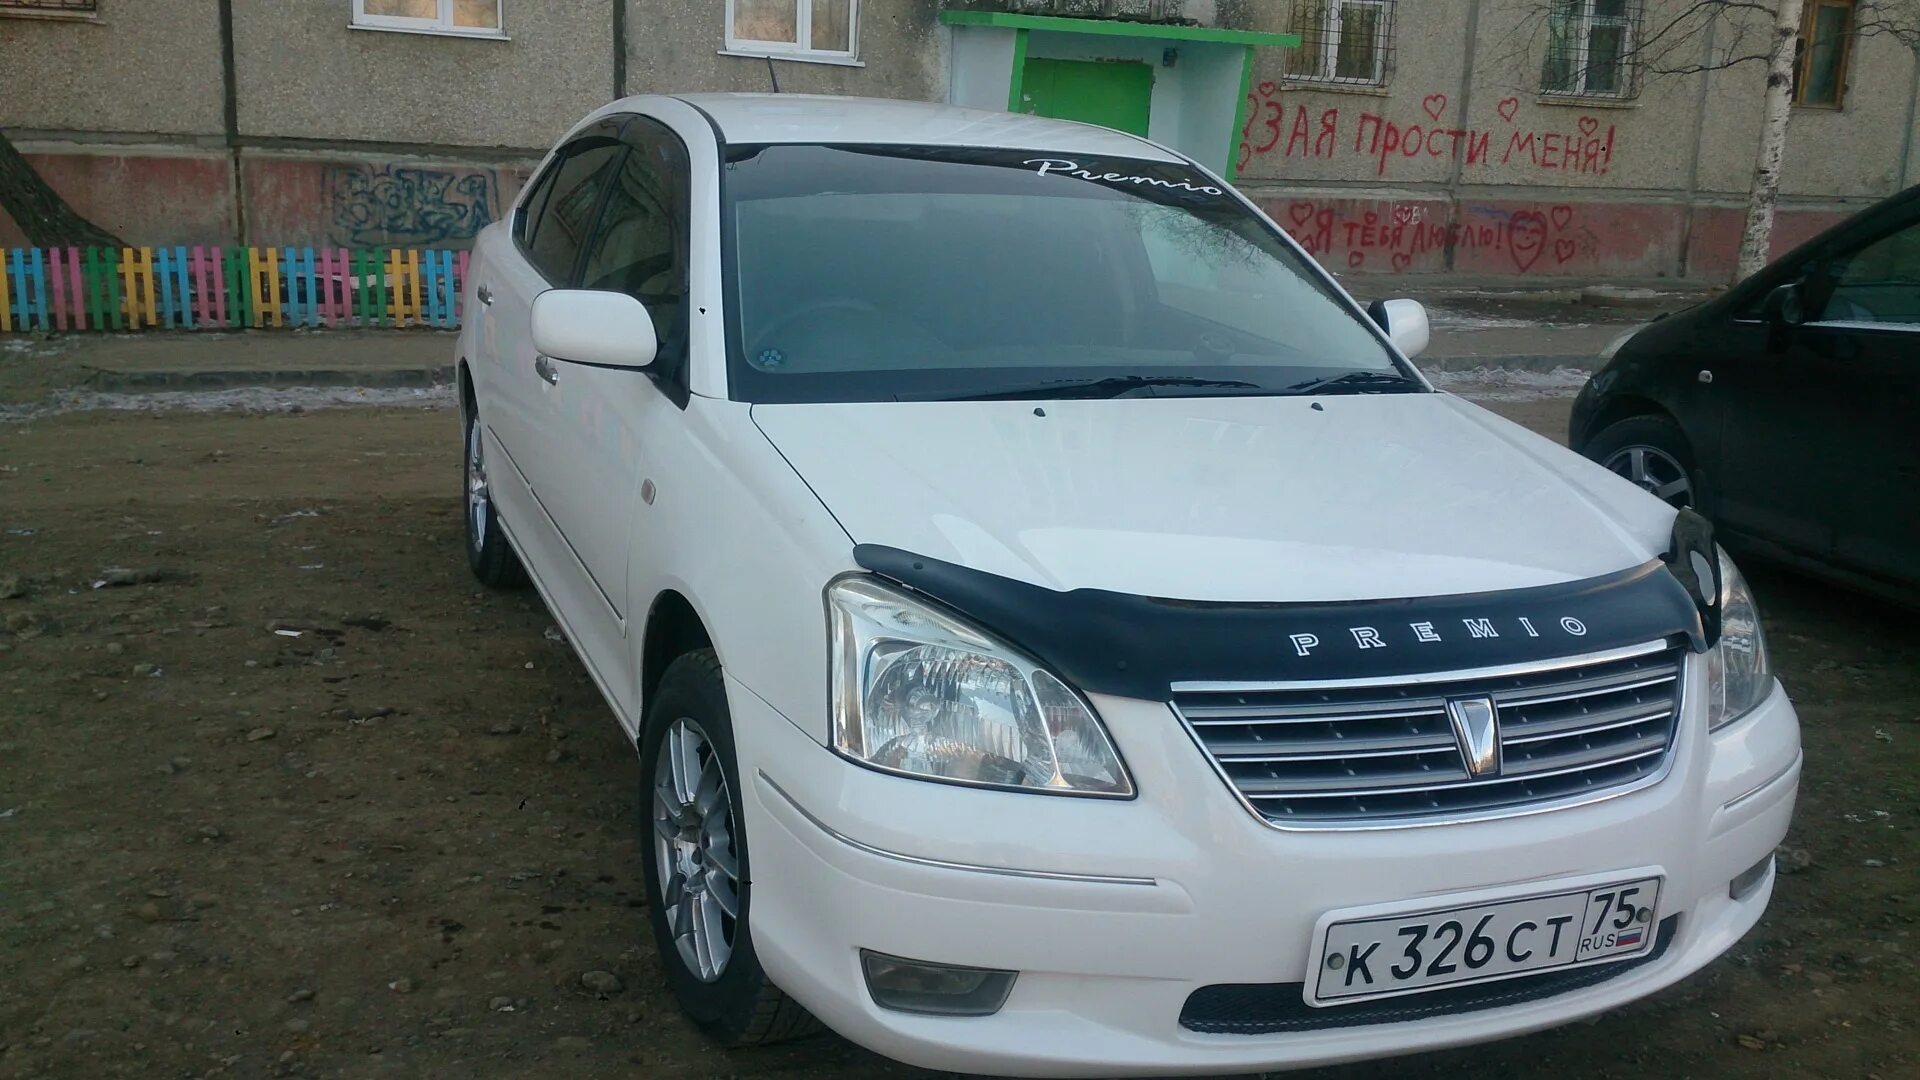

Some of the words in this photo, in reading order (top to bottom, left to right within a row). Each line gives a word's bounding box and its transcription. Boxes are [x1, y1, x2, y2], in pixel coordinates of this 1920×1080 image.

[1255, 101, 1338, 159] ЗАЯ
[1502, 125, 1616, 175] МЕНЯ!
[1022, 158, 1223, 196] Premio
[1289, 616, 1587, 656] PREMIO
[1592, 887, 1640, 935] 75
[1580, 933, 1616, 953] RUS
